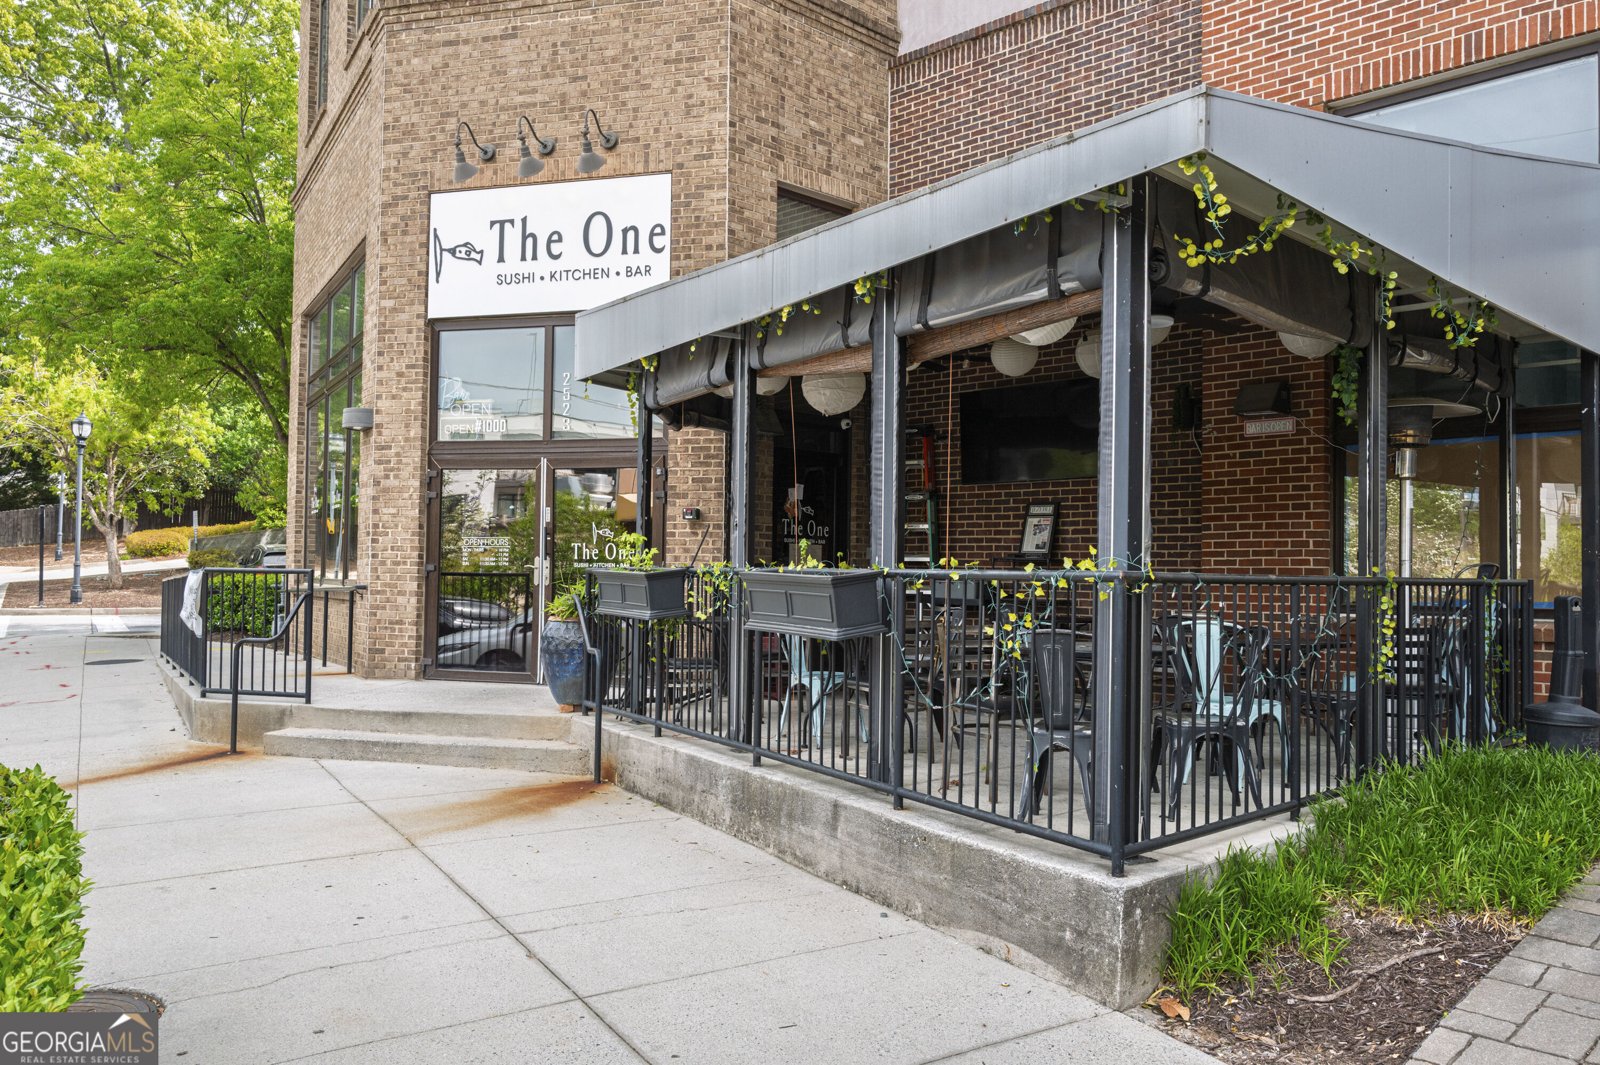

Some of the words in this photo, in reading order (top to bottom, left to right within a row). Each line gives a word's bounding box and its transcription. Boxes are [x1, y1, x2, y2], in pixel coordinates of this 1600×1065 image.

[489, 215, 563, 264] The
[582, 211, 666, 258] One
[496, 272, 535, 285] SUSHI
[549, 267, 610, 282] KITCHEN
[625, 265, 652, 278] BAR
[450, 403, 492, 416] OPEN
[444, 424, 474, 434] OPEN
[475, 419, 506, 433] #1000
[807, 520, 829, 537] One
[463, 538, 483, 546] OPEN
[485, 538, 509, 546] HOURS
[571, 542, 599, 560] The
